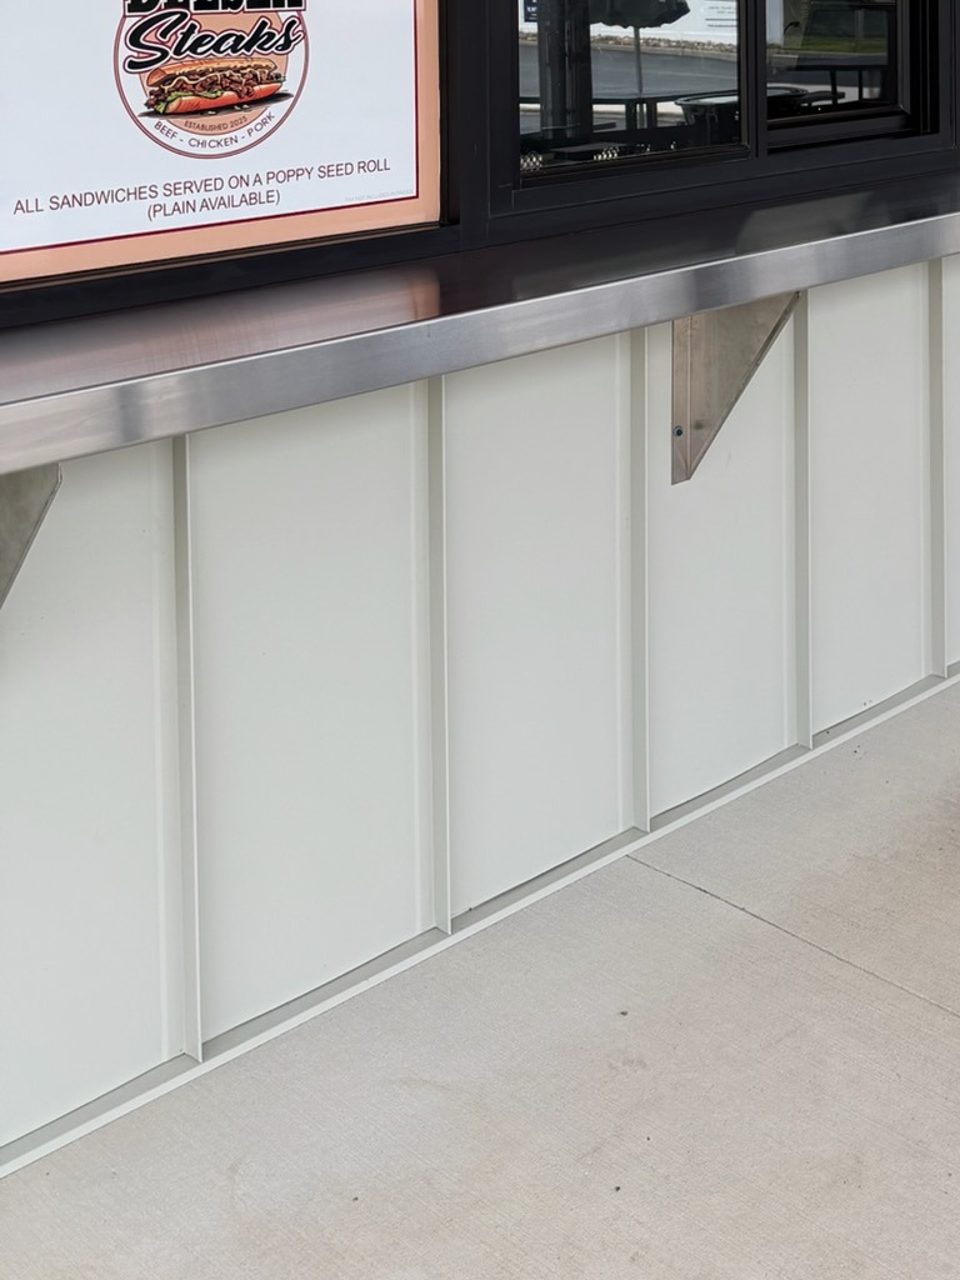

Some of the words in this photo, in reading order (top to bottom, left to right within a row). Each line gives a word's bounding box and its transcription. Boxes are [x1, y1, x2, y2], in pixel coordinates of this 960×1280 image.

[124, 10, 304, 72] Steaks
[154, 121, 178, 139] BEEF
[188, 135, 238, 148] CHICKEN
[247, 112, 275, 137] PORK
[13, 198, 44, 215] ALL
[49, 185, 158, 210] SANDWICHES
[163, 177, 224, 198] SERVED
[229, 174, 250, 190] ON
[253, 173, 263, 188] A
[267, 167, 314, 185] POPPY
[317, 162, 354, 179] SEED
[358, 158, 390, 174] ROLL
[147, 198, 196, 221] (PLAIN
[200, 190, 280, 214] AVAILABLE)
